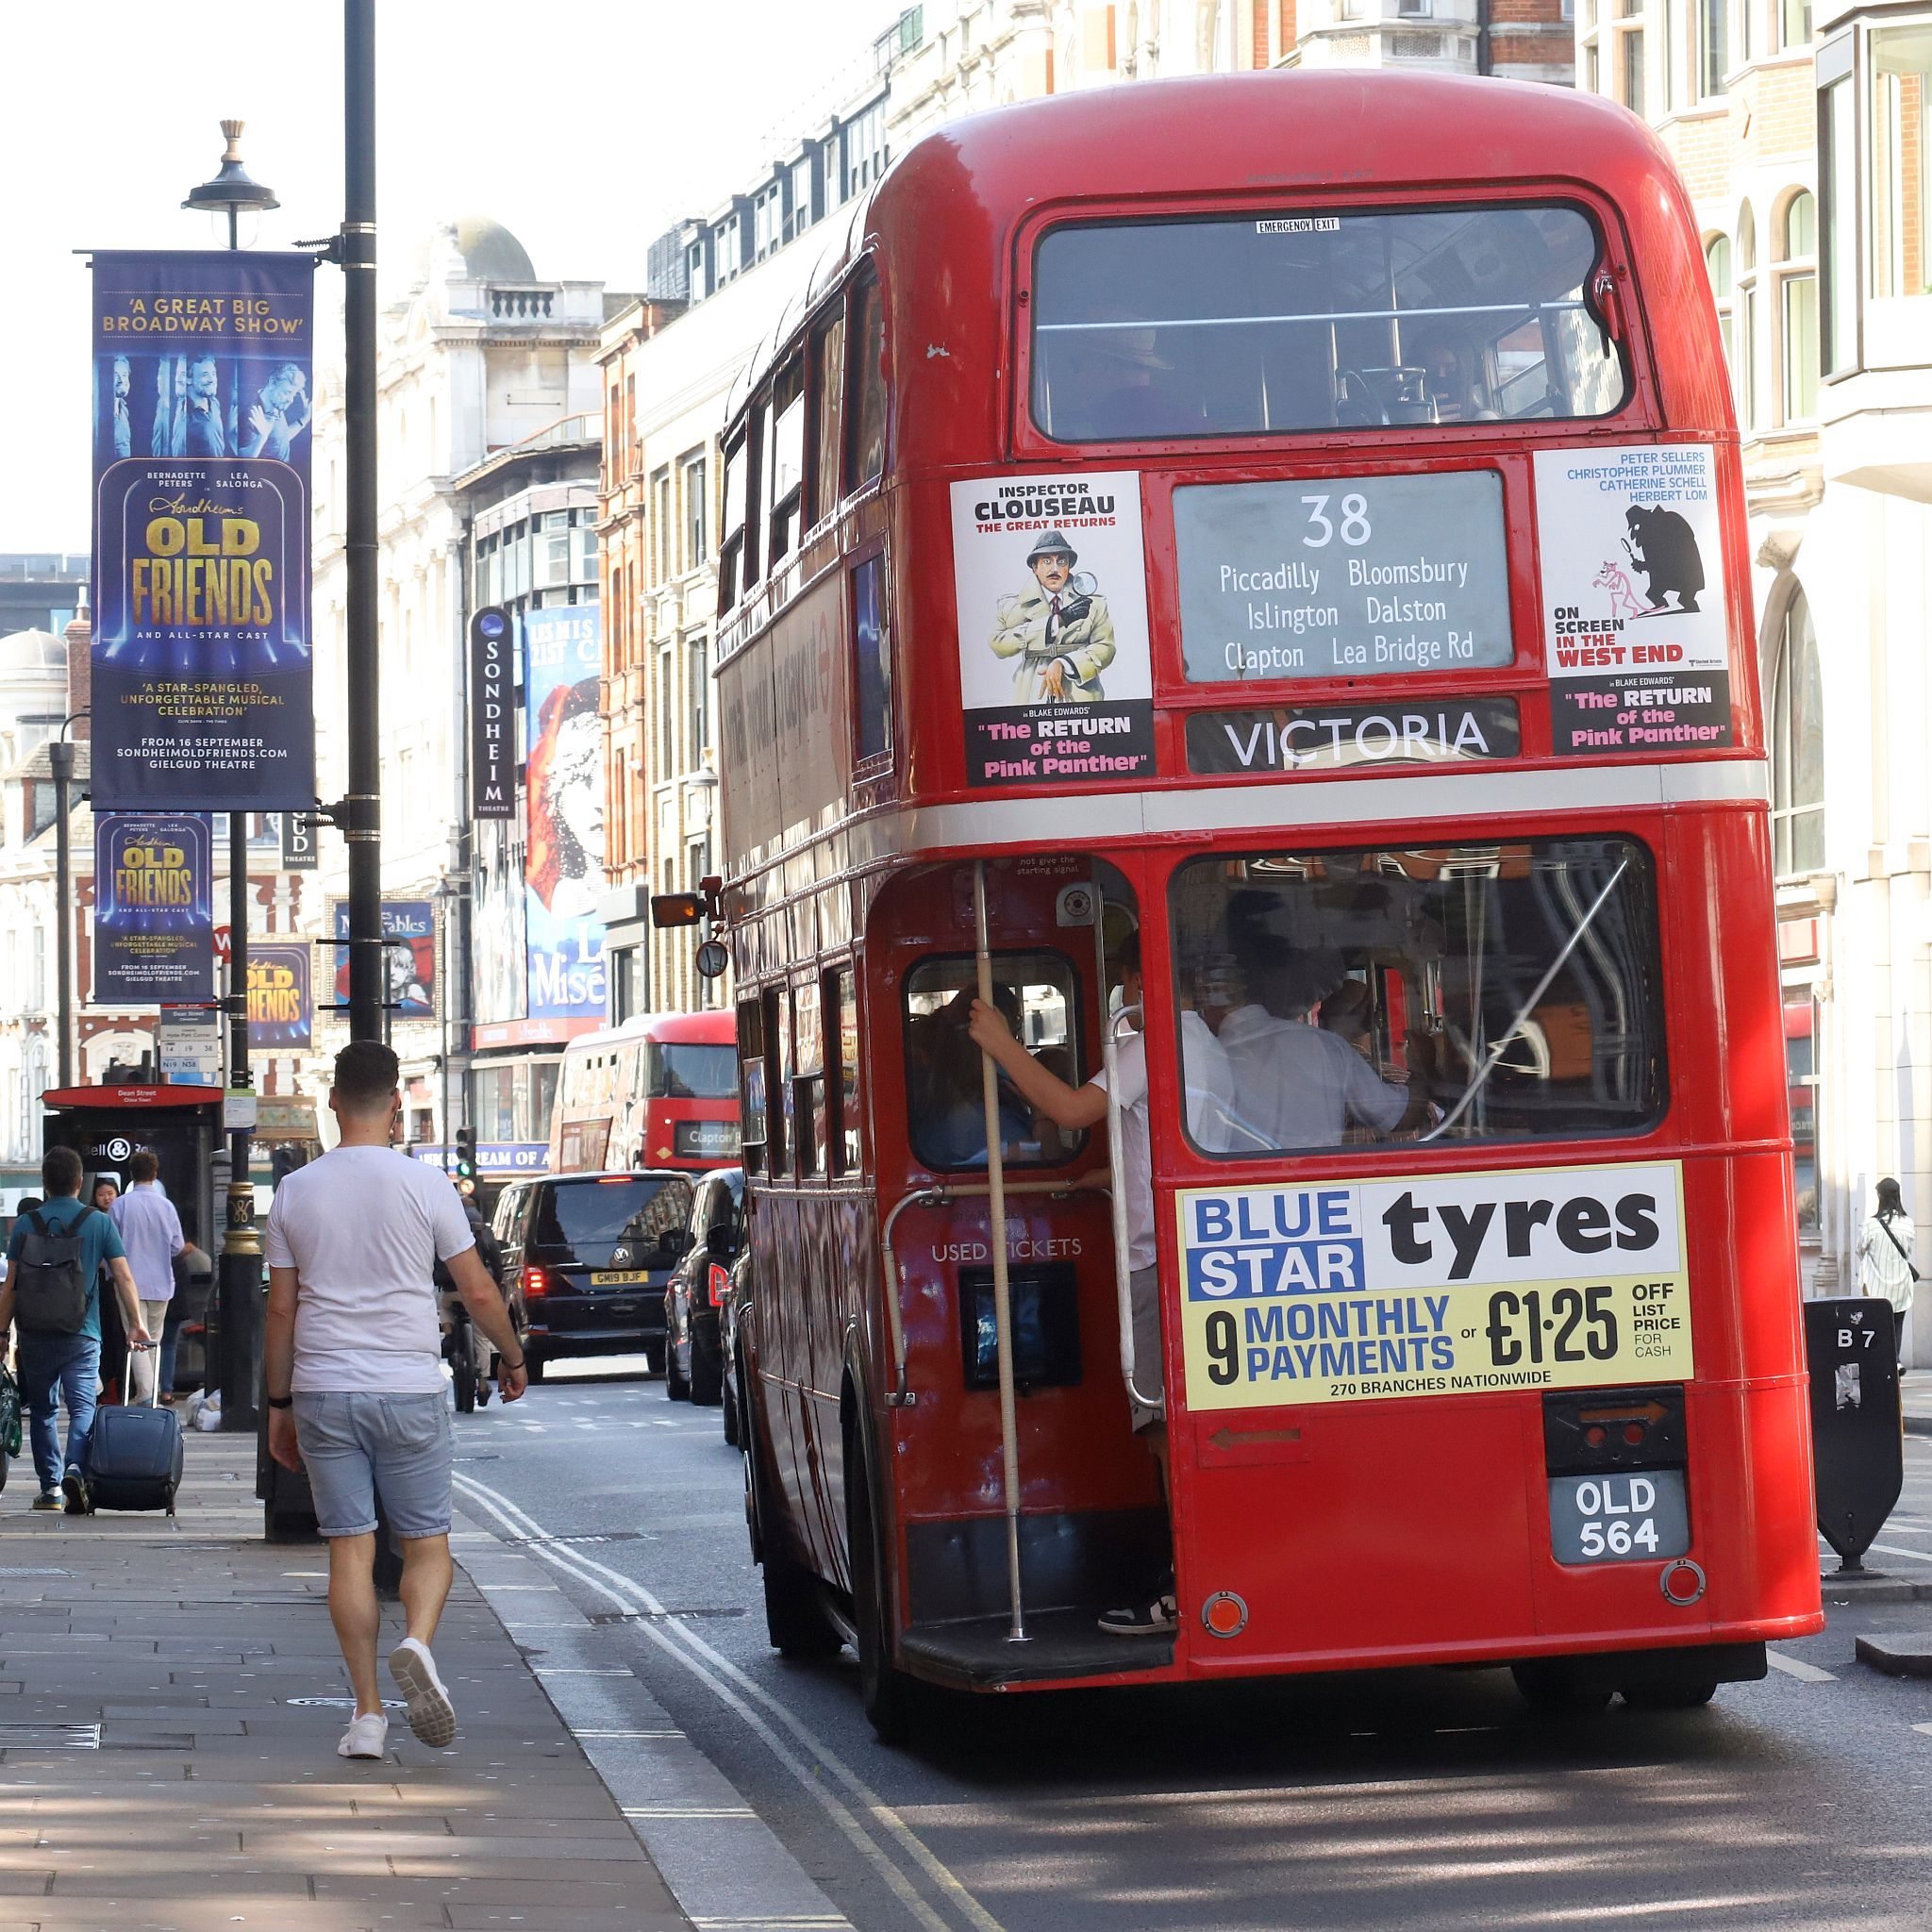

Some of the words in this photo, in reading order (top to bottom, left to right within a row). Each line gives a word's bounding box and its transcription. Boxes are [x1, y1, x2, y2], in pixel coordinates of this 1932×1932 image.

[1259, 220, 1311, 233] EMERGENCY
[1316, 219, 1336, 230] EXIT
[154, 299, 225, 314] GREAT
[232, 299, 270, 315] BIG
[103, 317, 226, 331] BROADWAY
[234, 318, 303, 333] SHOW'
[1621, 453, 1658, 464] PETER
[1661, 452, 1705, 462] SELLERS
[1567, 466, 1648, 479] CHRISTOPHER
[1652, 464, 1706, 475] PLUMMER
[998, 483, 1089, 498] INSPECTOR
[1600, 478, 1666, 491] CATHERINE
[1669, 477, 1707, 488] SCHELL
[1629, 490, 1682, 502] HERBERT
[1686, 490, 1707, 501] LOM
[974, 495, 1115, 521] CLOUSEAU
[976, 523, 1002, 534] THE
[1007, 520, 1049, 531] GREAT
[1054, 517, 1116, 528] RETURNS
[1301, 492, 1372, 548] 38
[146, 517, 259, 556] OLD
[1220, 561, 1320, 595] Piccadilly
[1348, 558, 1468, 589] Bloomsbury
[133, 558, 273, 627] FRIENDS
[1247, 603, 1339, 634] Islington
[1367, 596, 1446, 624] Dalston
[1554, 607, 1579, 619] ON
[1555, 619, 1624, 634] SCREEN
[169, 631, 230, 640] ALL-STAR
[237, 631, 269, 640] CAST
[1556, 635, 1575, 648] IN
[1581, 633, 1615, 646] THE
[1224, 642, 1304, 675] Clapton
[1332, 637, 1367, 665] Lea
[1375, 634, 1441, 667] Bridge
[1448, 631, 1474, 658] Rd
[1557, 646, 1626, 668] WEST
[1632, 644, 1683, 664] END
[157, 683, 262, 694] STAR-SPANGLED,
[1615, 678, 1638, 687] BLAKE
[1640, 676, 1674, 685] EDWARDS'
[121, 695, 225, 705] UNFORGETTABLE
[229, 695, 284, 705] MUSICAL
[1624, 687, 1712, 707] RETURN
[158, 707, 247, 716] CELEBRATION'
[1029, 708, 1052, 718] BLAKE
[1054, 707, 1091, 716] EDWARDS'
[1616, 710, 1637, 724] of
[1641, 709, 1675, 724] the
[484, 641, 503, 801] SONDHEIM
[1038, 717, 1131, 738] RETURN
[142, 738, 175, 746] FROM
[179, 738, 191, 746] 16
[195, 738, 263, 747] SEPTEMBER
[1224, 711, 1490, 766] VICTORIA
[1572, 728, 1623, 746] Pink
[117, 748, 287, 758] SONDHEIMOLDFRIENDS.COM
[1030, 741, 1052, 756] of
[1056, 739, 1091, 755] the
[149, 759, 201, 769] GIELGUD
[205, 760, 256, 770] THEATRE
[984, 758, 1037, 778] Pink
[123, 847, 185, 869] OLD
[1039, 857, 1057, 866] give
[1060, 855, 1075, 863] the
[1017, 866, 1050, 875] starting
[1055, 865, 1078, 874] signal
[116, 869, 192, 906] FRIENDS
[690, 1130, 732, 1145] Clapton
[475, 1151, 510, 1166] REAM
[516, 1151, 537, 1166] OF
[1194, 1191, 1352, 1243] BLUE
[1382, 1191, 1659, 1280] tyres
[931, 1242, 987, 1262] USED
[1199, 1245, 1356, 1297] STAR
[1632, 1283, 1674, 1301] OFF
[1633, 1304, 1665, 1317] LIST
[1633, 1317, 1681, 1332] PRICE
[1206, 1309, 1240, 1386] 9
[1244, 1295, 1449, 1343] MONTHLY
[1460, 1326, 1476, 1339] or
[1634, 1333, 1662, 1345] FOR
[1838, 1328, 1854, 1348] B
[1861, 1330, 1875, 1348] 7
[1247, 1335, 1455, 1382] PAYMENTS
[1635, 1345, 1672, 1358] CASH
[1330, 1382, 1357, 1396] 270
[1360, 1376, 1447, 1395] BRANCHES
[1451, 1370, 1552, 1391] NATIONWIDE
[1575, 1478, 1656, 1516] OLD
[1579, 1518, 1659, 1557] 564
